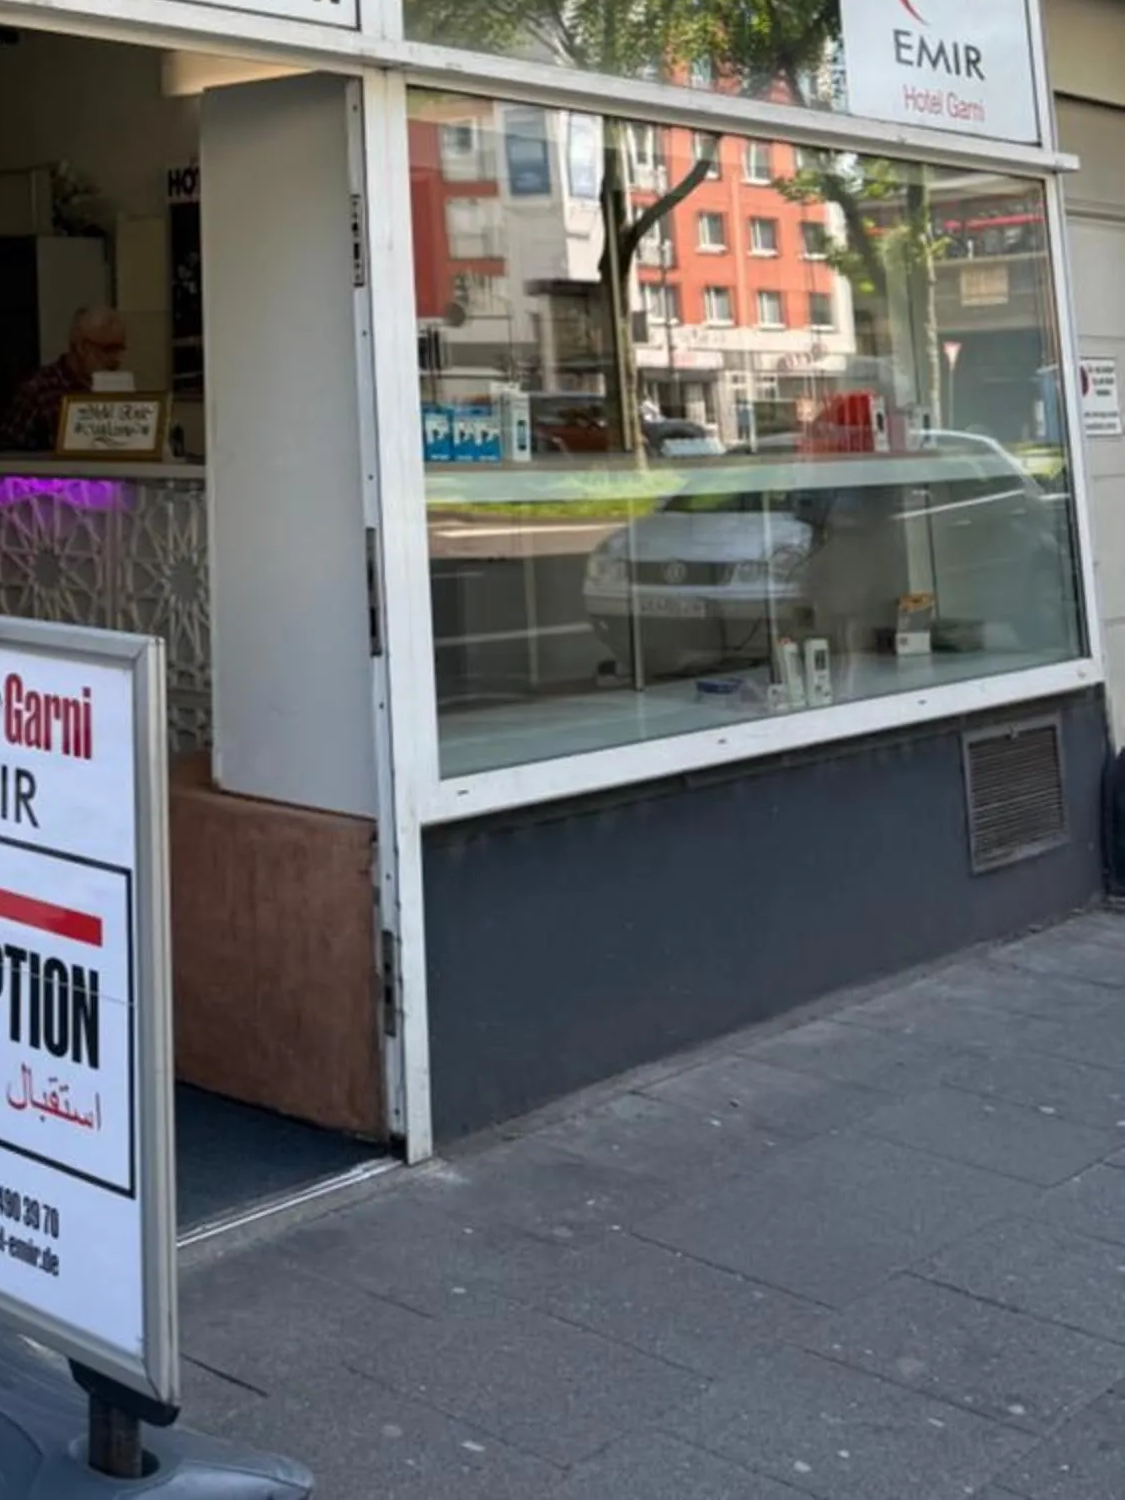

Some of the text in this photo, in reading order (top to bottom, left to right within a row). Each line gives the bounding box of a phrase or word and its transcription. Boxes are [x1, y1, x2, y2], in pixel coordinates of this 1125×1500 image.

[892, 28, 986, 81] EMIR
[903, 85, 986, 122] Hotel Garni
[4, 673, 93, 761] Garni
